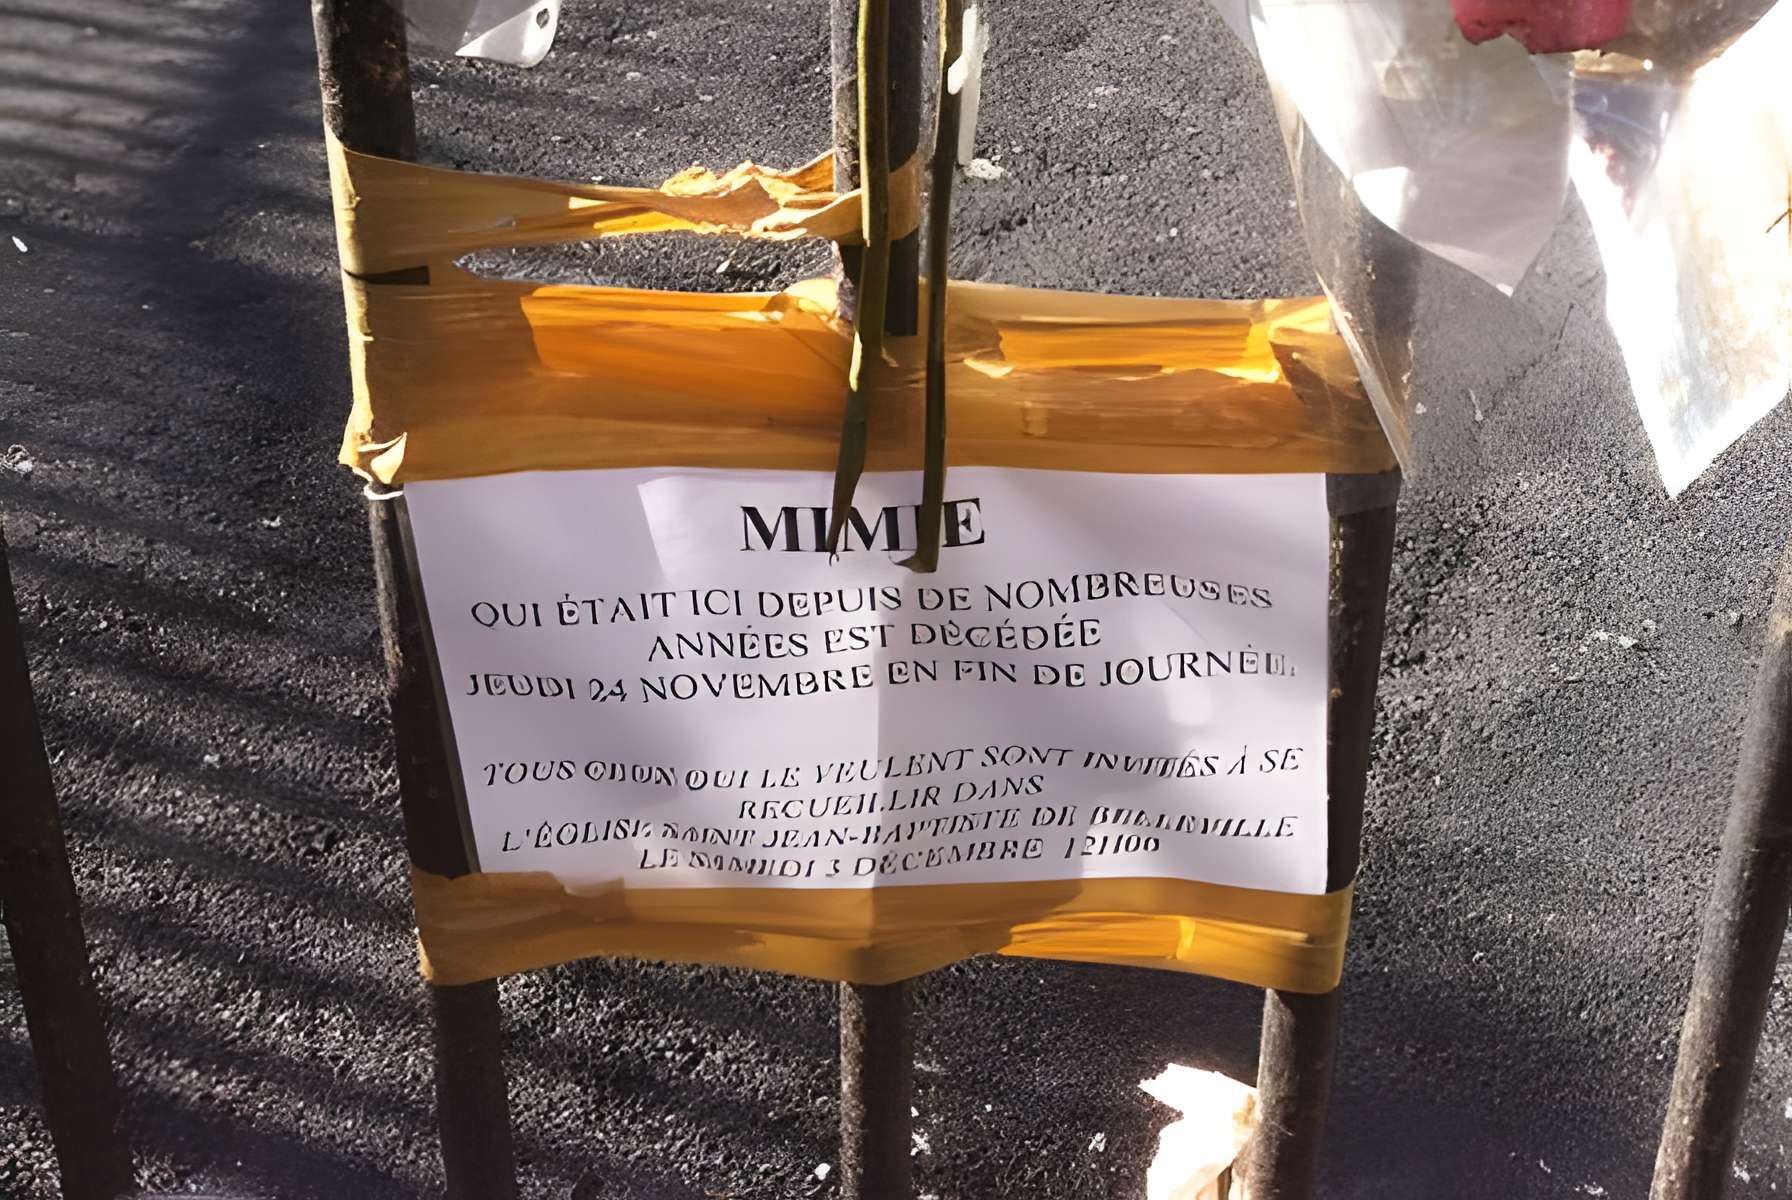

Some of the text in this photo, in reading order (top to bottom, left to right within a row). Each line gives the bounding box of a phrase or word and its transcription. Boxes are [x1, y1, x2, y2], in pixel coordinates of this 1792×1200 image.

[740, 497, 985, 553] MIMIE
[470, 571, 1273, 631] QUI ÉTAIT ICI DEPUIS DE NOMBREUSES
[648, 624, 810, 662] ANNÉES
[825, 623, 895, 656] EST
[465, 672, 575, 701] JEUDI
[640, 663, 875, 704] NOVEMBRE
[887, 660, 938, 684] EN
[954, 659, 1018, 684] FIN
[1033, 663, 1087, 689] DE
[483, 759, 577, 787] TOUS
[760, 765, 802, 790] LE
[815, 747, 976, 786] VEULENT
[980, 744, 1076, 770] SONT
[1259, 745, 1306, 774] SE
[952, 772, 1047, 804] DANS
[638, 847, 681, 871] LE
